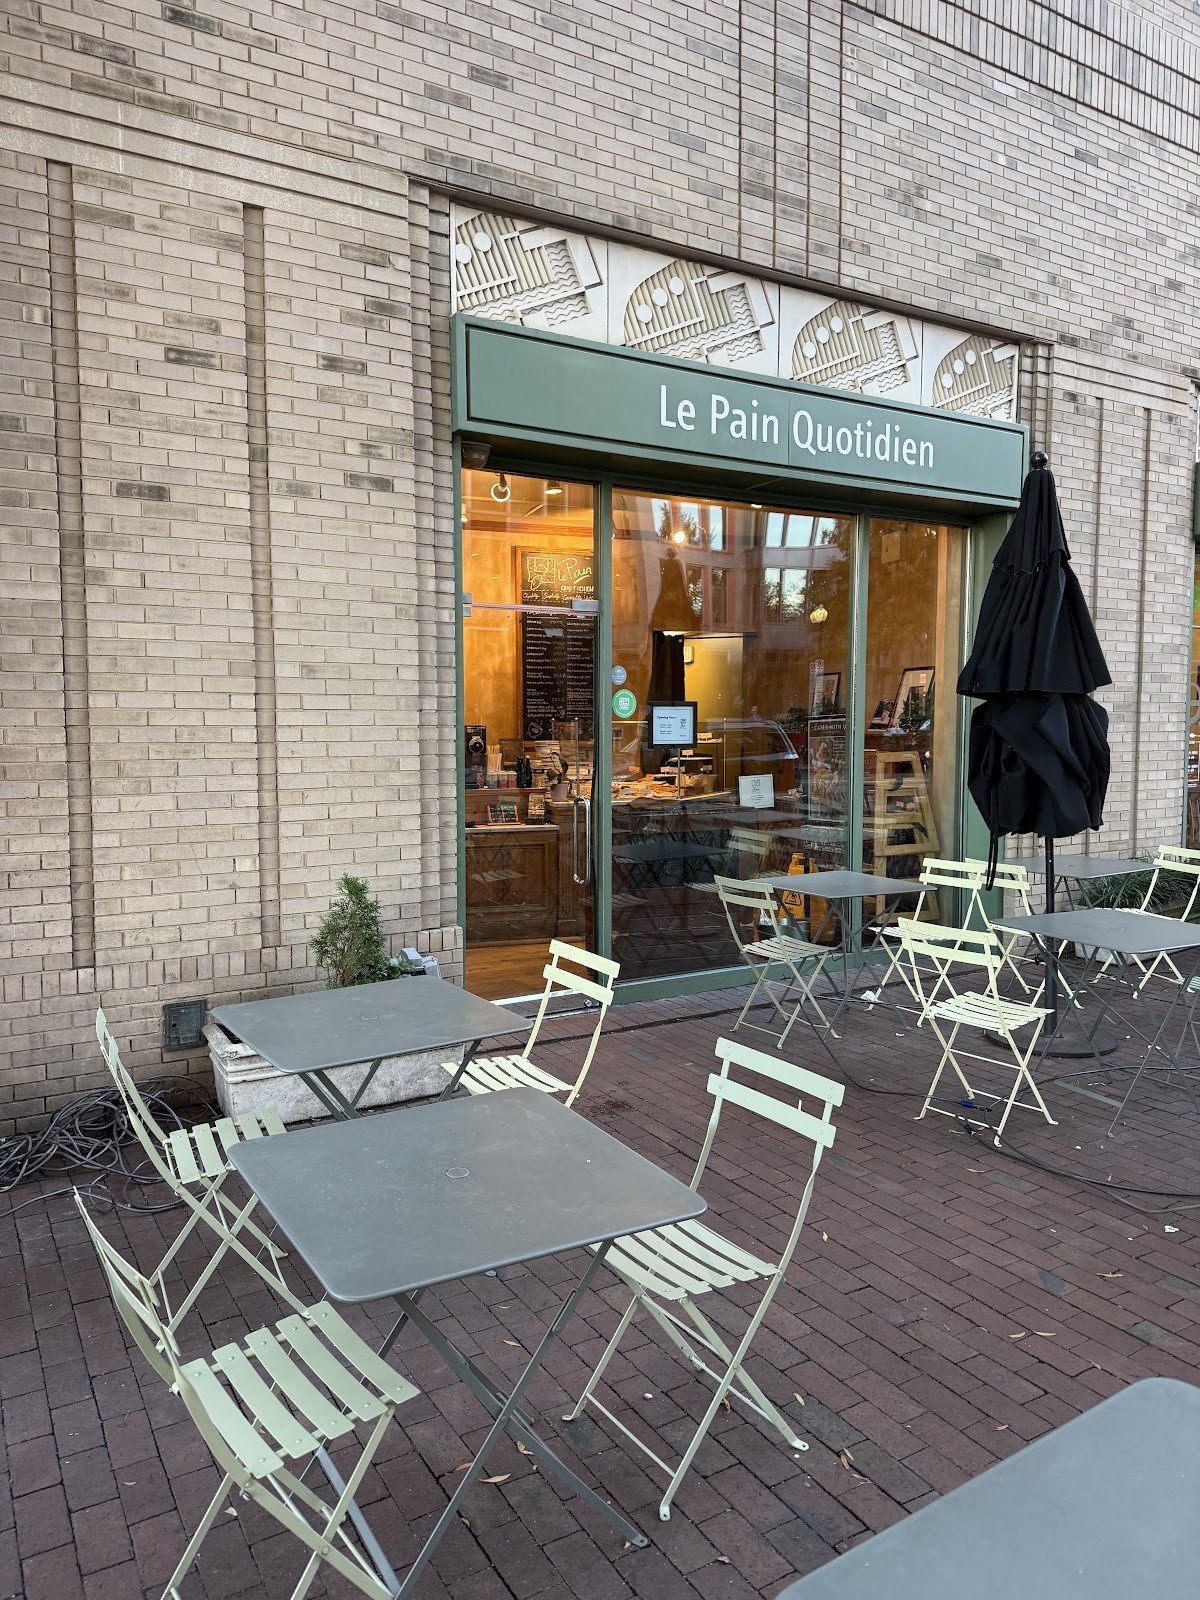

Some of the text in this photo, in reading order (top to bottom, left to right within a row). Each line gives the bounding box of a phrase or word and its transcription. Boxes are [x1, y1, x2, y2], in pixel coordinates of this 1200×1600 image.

[659, 384, 934, 468] Le Pain Quotidien
[558, 557, 593, 579] Pain
[560, 585, 594, 593] QUOTIDIEN
